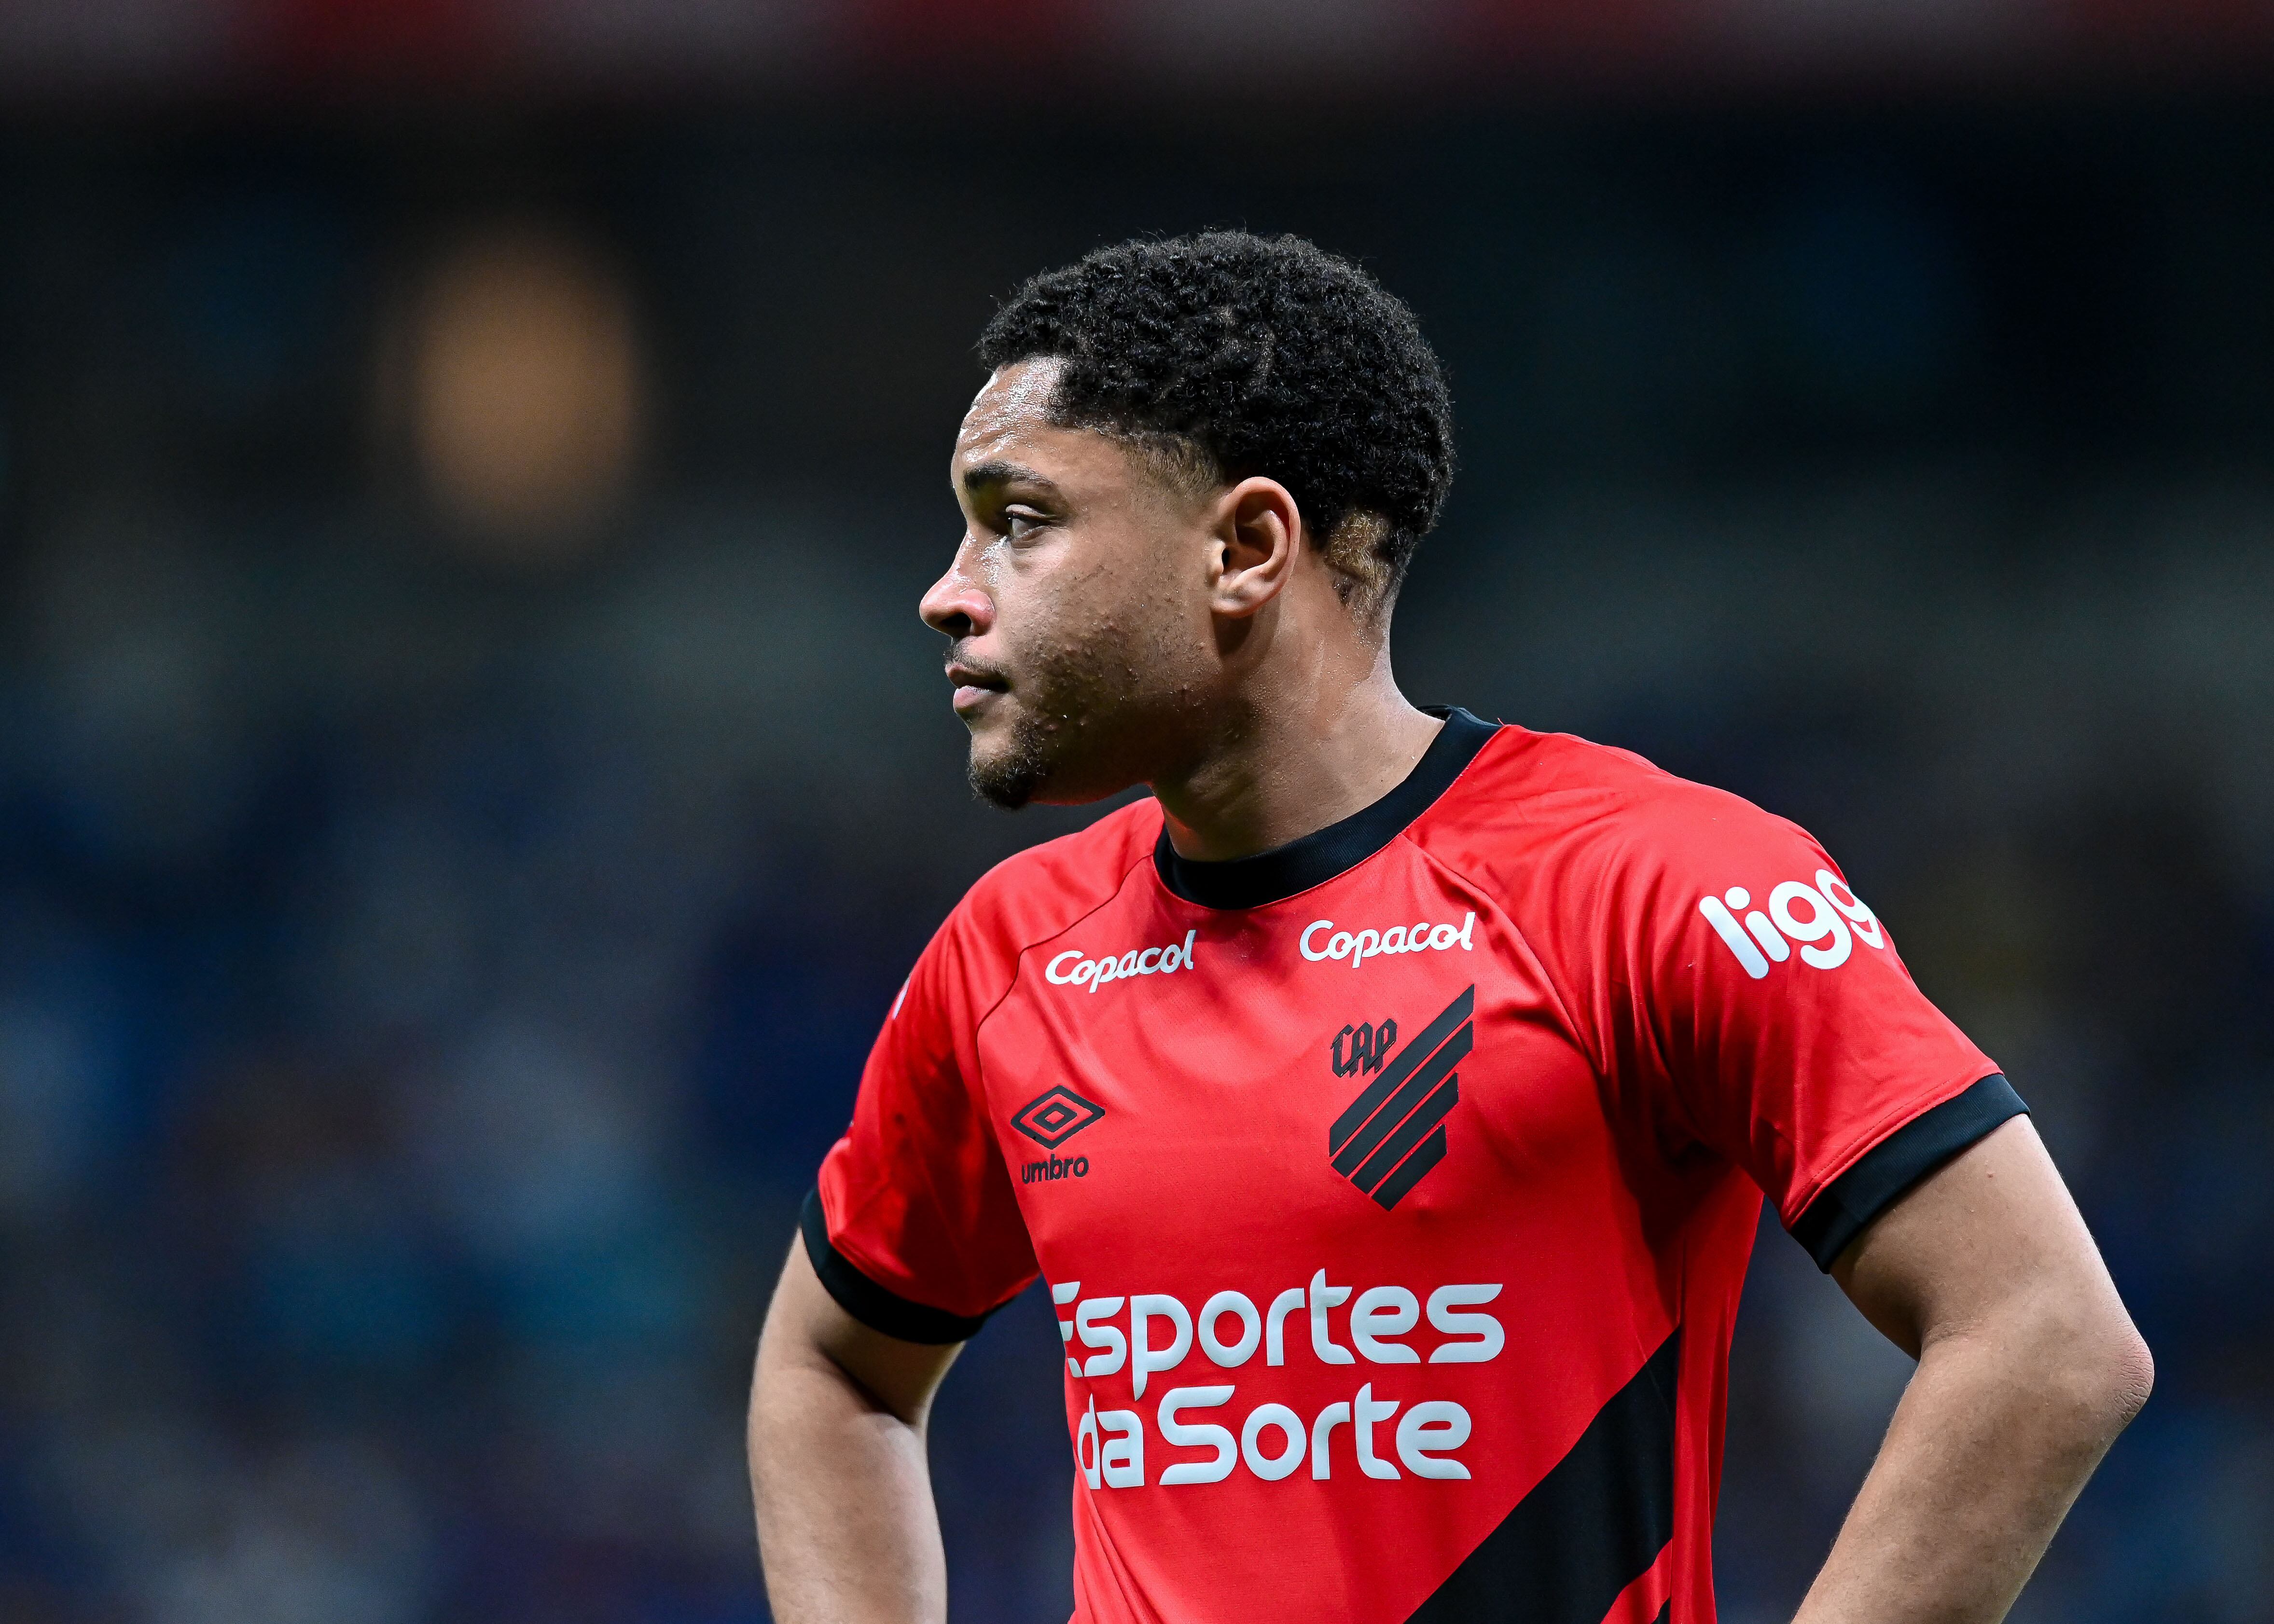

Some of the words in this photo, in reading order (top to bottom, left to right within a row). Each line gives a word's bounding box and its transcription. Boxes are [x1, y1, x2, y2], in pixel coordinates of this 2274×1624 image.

[1045, 930, 1194, 993] Copacol
[1300, 912, 1475, 968] Copacol
[1331, 1018, 1398, 1077] CAP
[1022, 1154, 1089, 1184] umbro
[1078, 1393, 1144, 1489] da
[1158, 1382, 1471, 1485] Sorte
